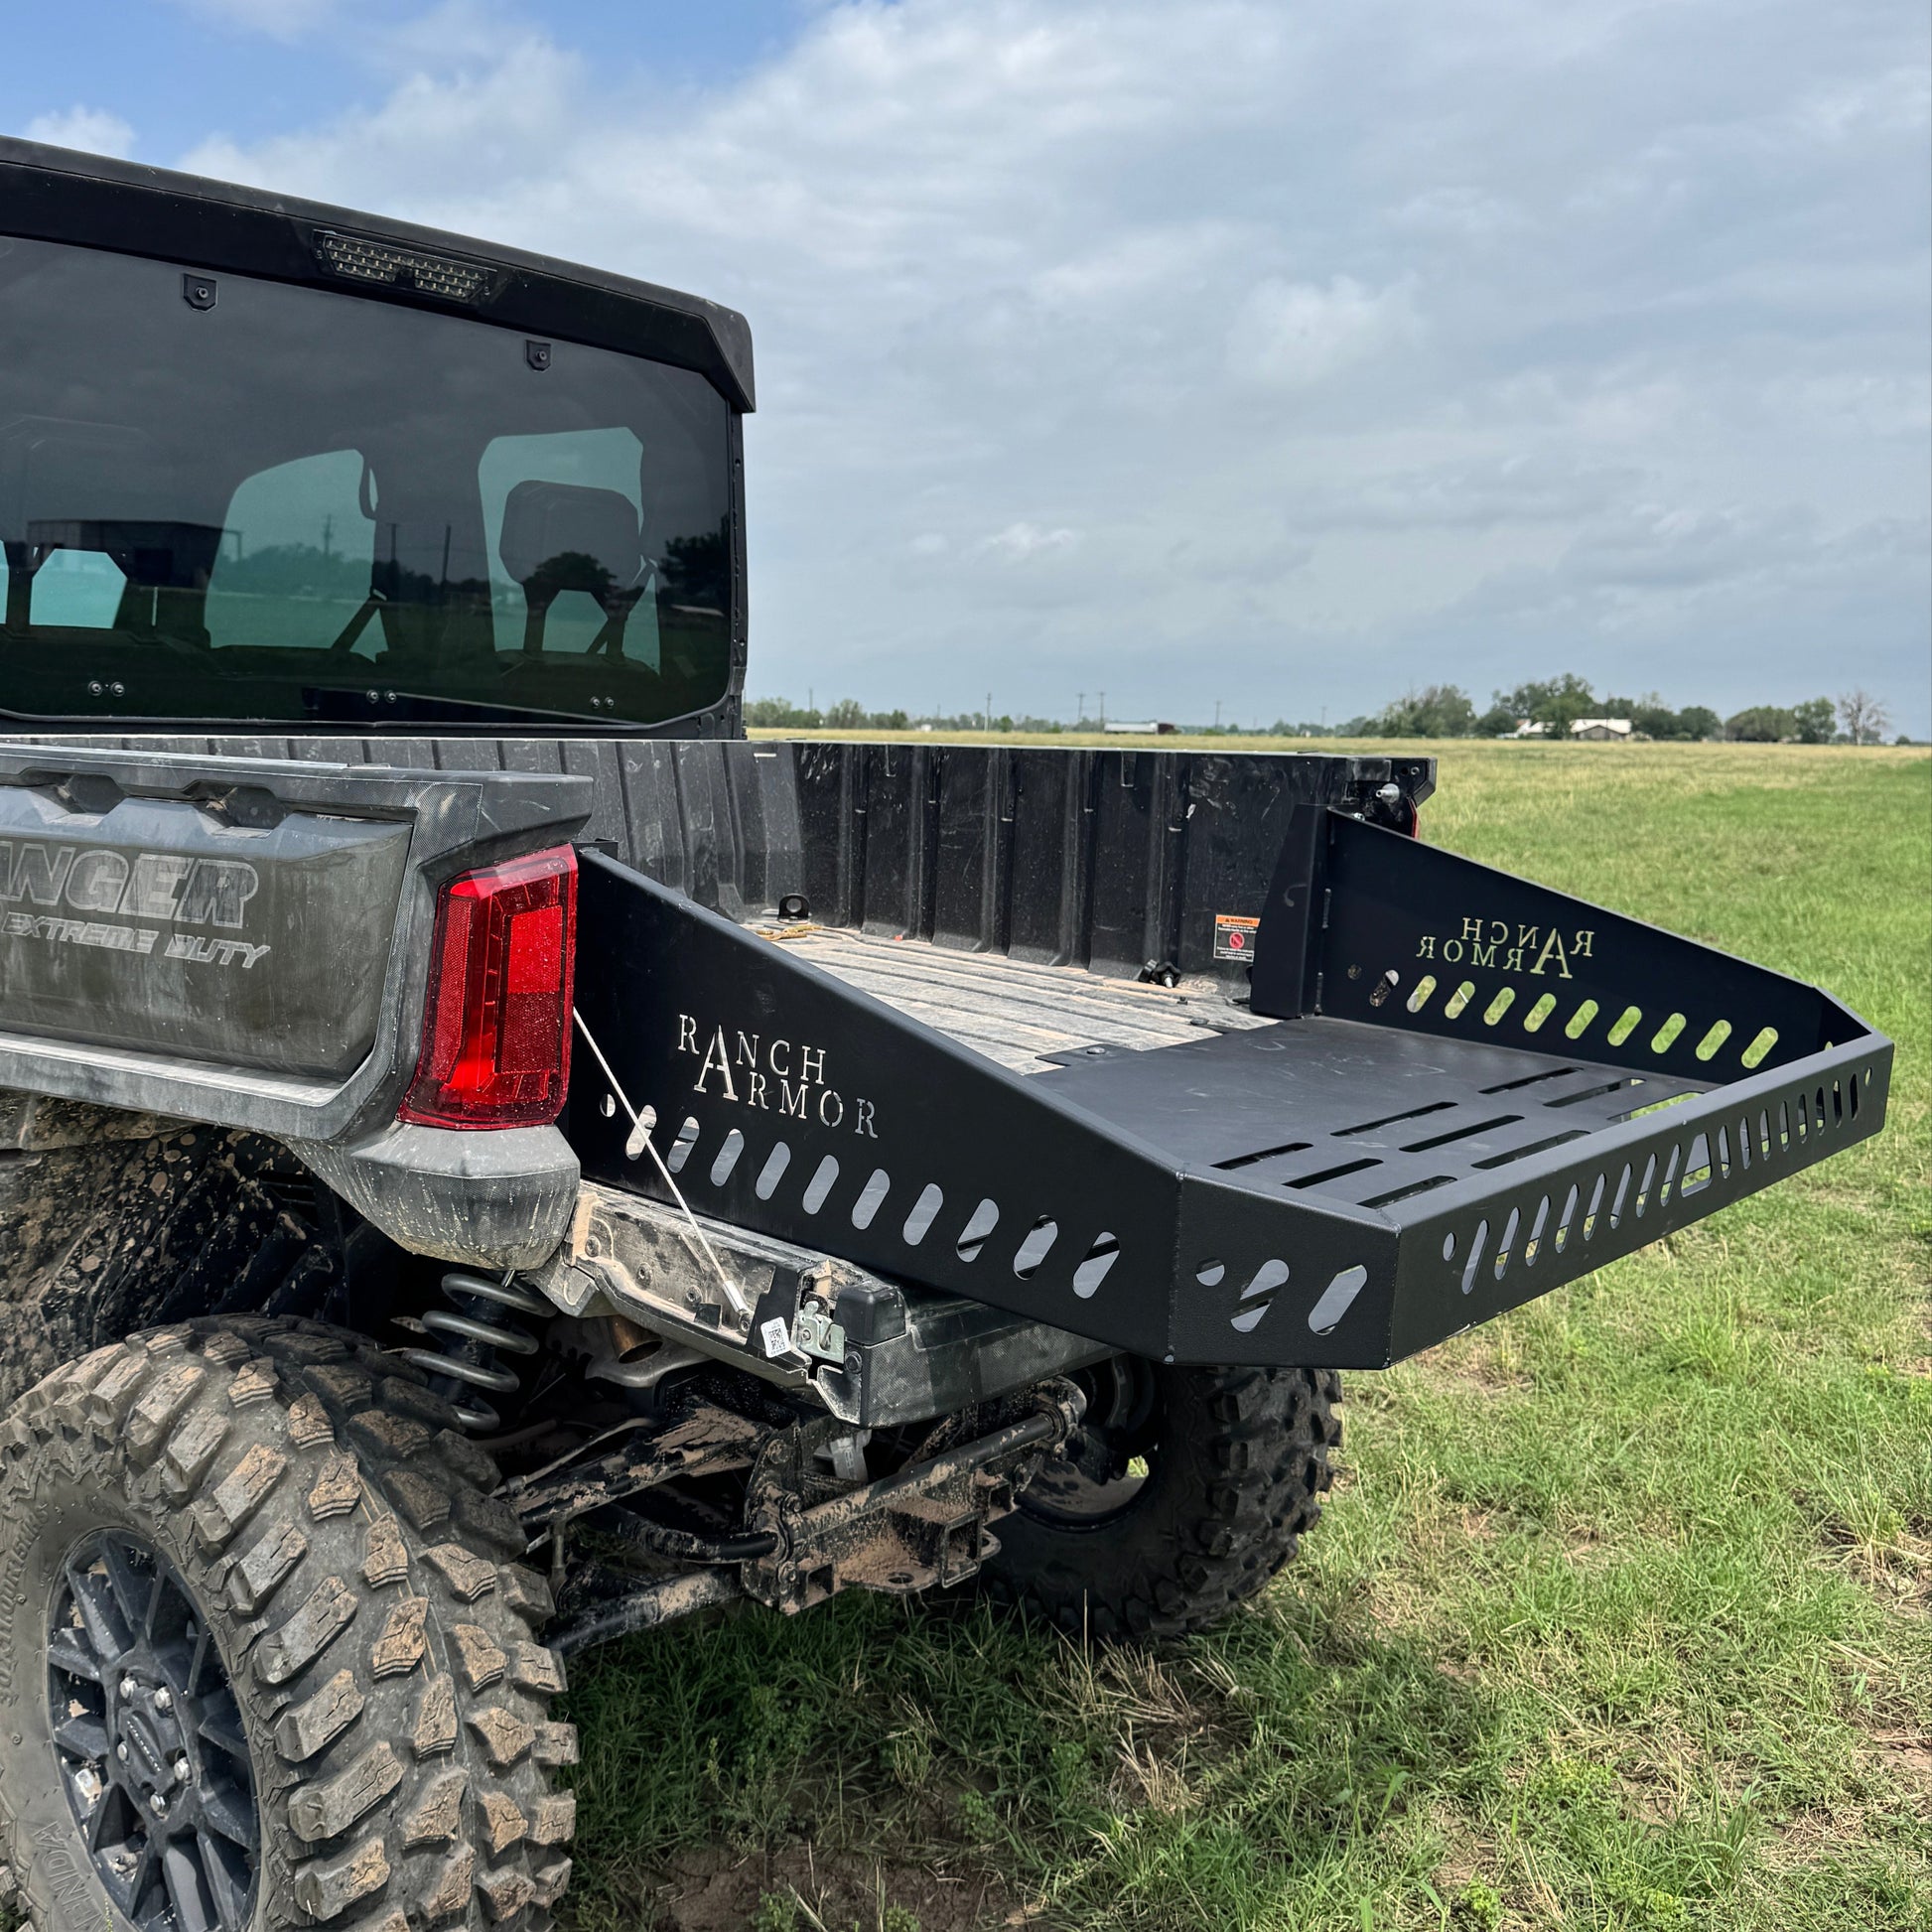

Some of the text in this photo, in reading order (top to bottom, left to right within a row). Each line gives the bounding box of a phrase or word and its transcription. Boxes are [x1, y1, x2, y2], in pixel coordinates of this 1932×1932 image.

[0, 841, 259, 929] NGER
[1, 911, 271, 969] EXTREME DUTY
[677, 1013, 827, 1102] RANCH
